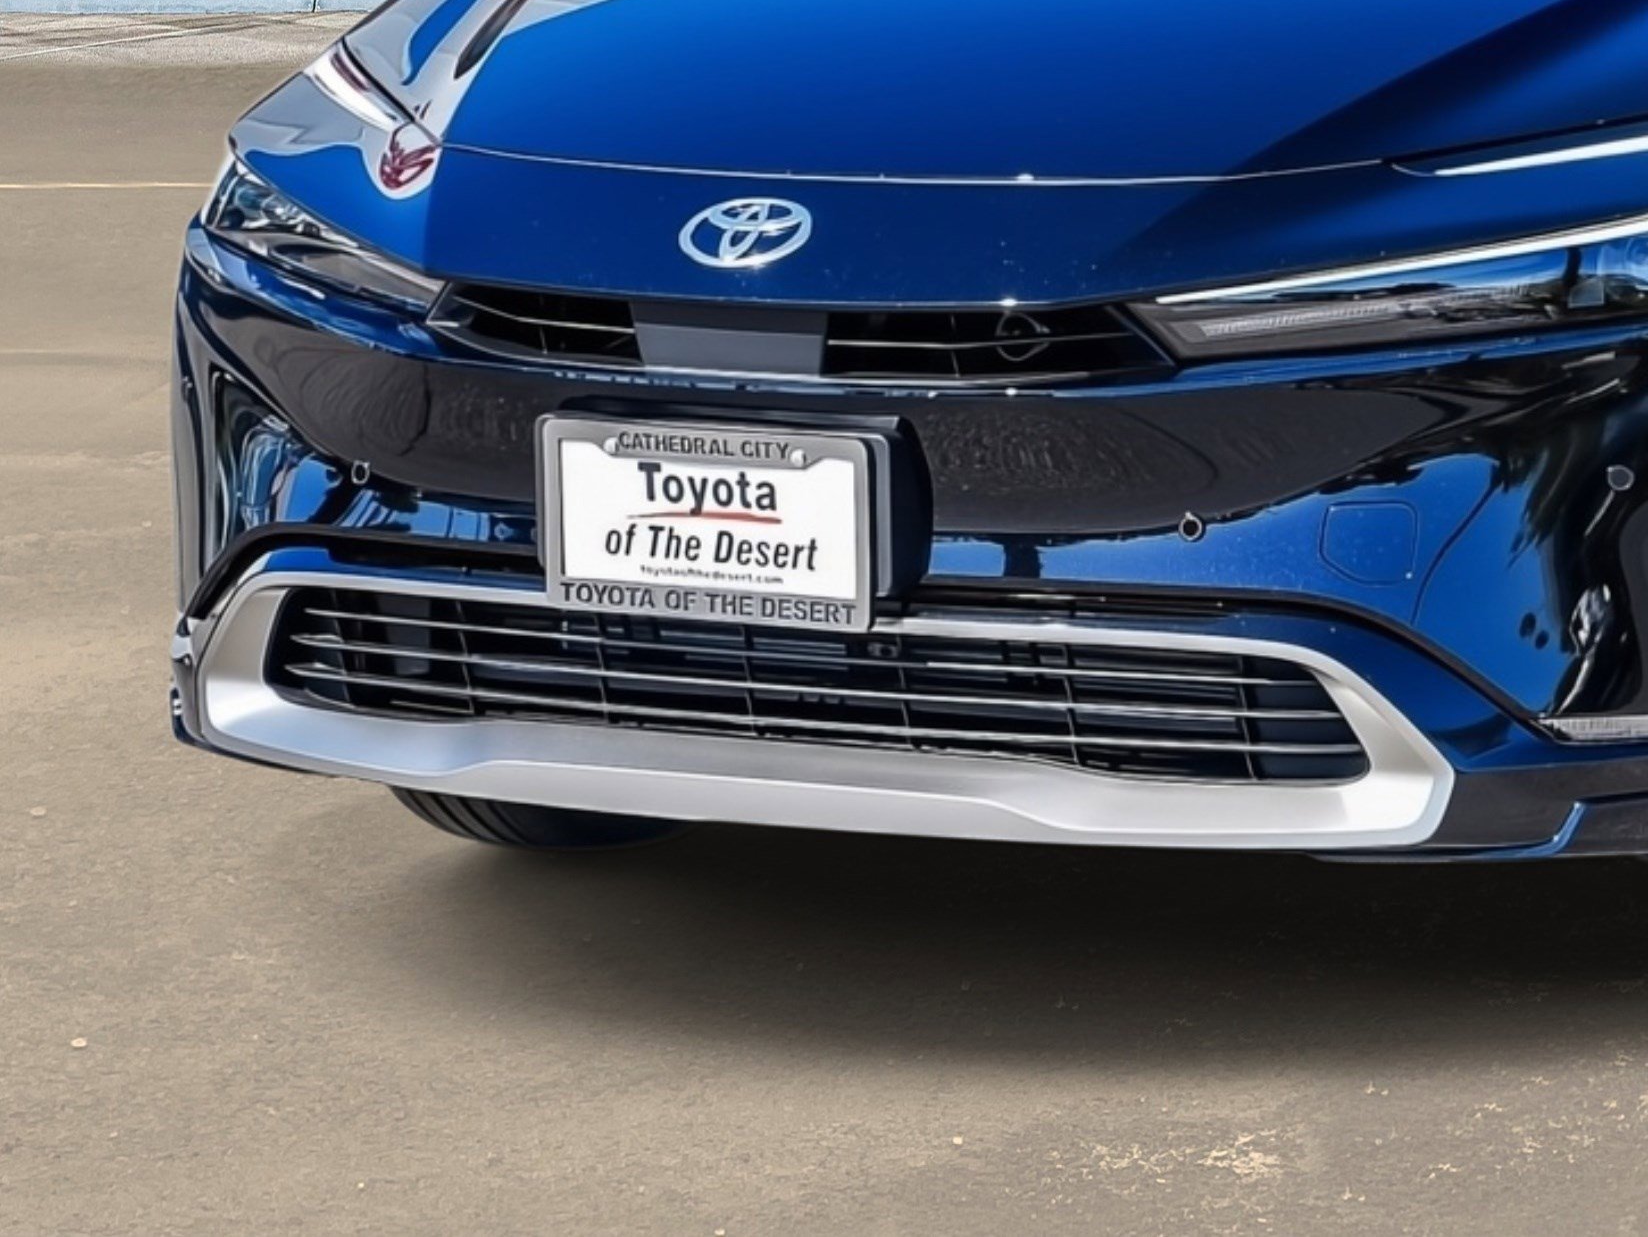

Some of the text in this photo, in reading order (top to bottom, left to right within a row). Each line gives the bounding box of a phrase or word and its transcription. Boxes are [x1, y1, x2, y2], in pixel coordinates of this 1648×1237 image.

[618, 431, 790, 460] CATHEDRAL CITY
[637, 462, 777, 515] Toyota
[605, 523, 818, 571] of The Desert
[560, 582, 857, 625] TOYOTA OF THE DESERT
